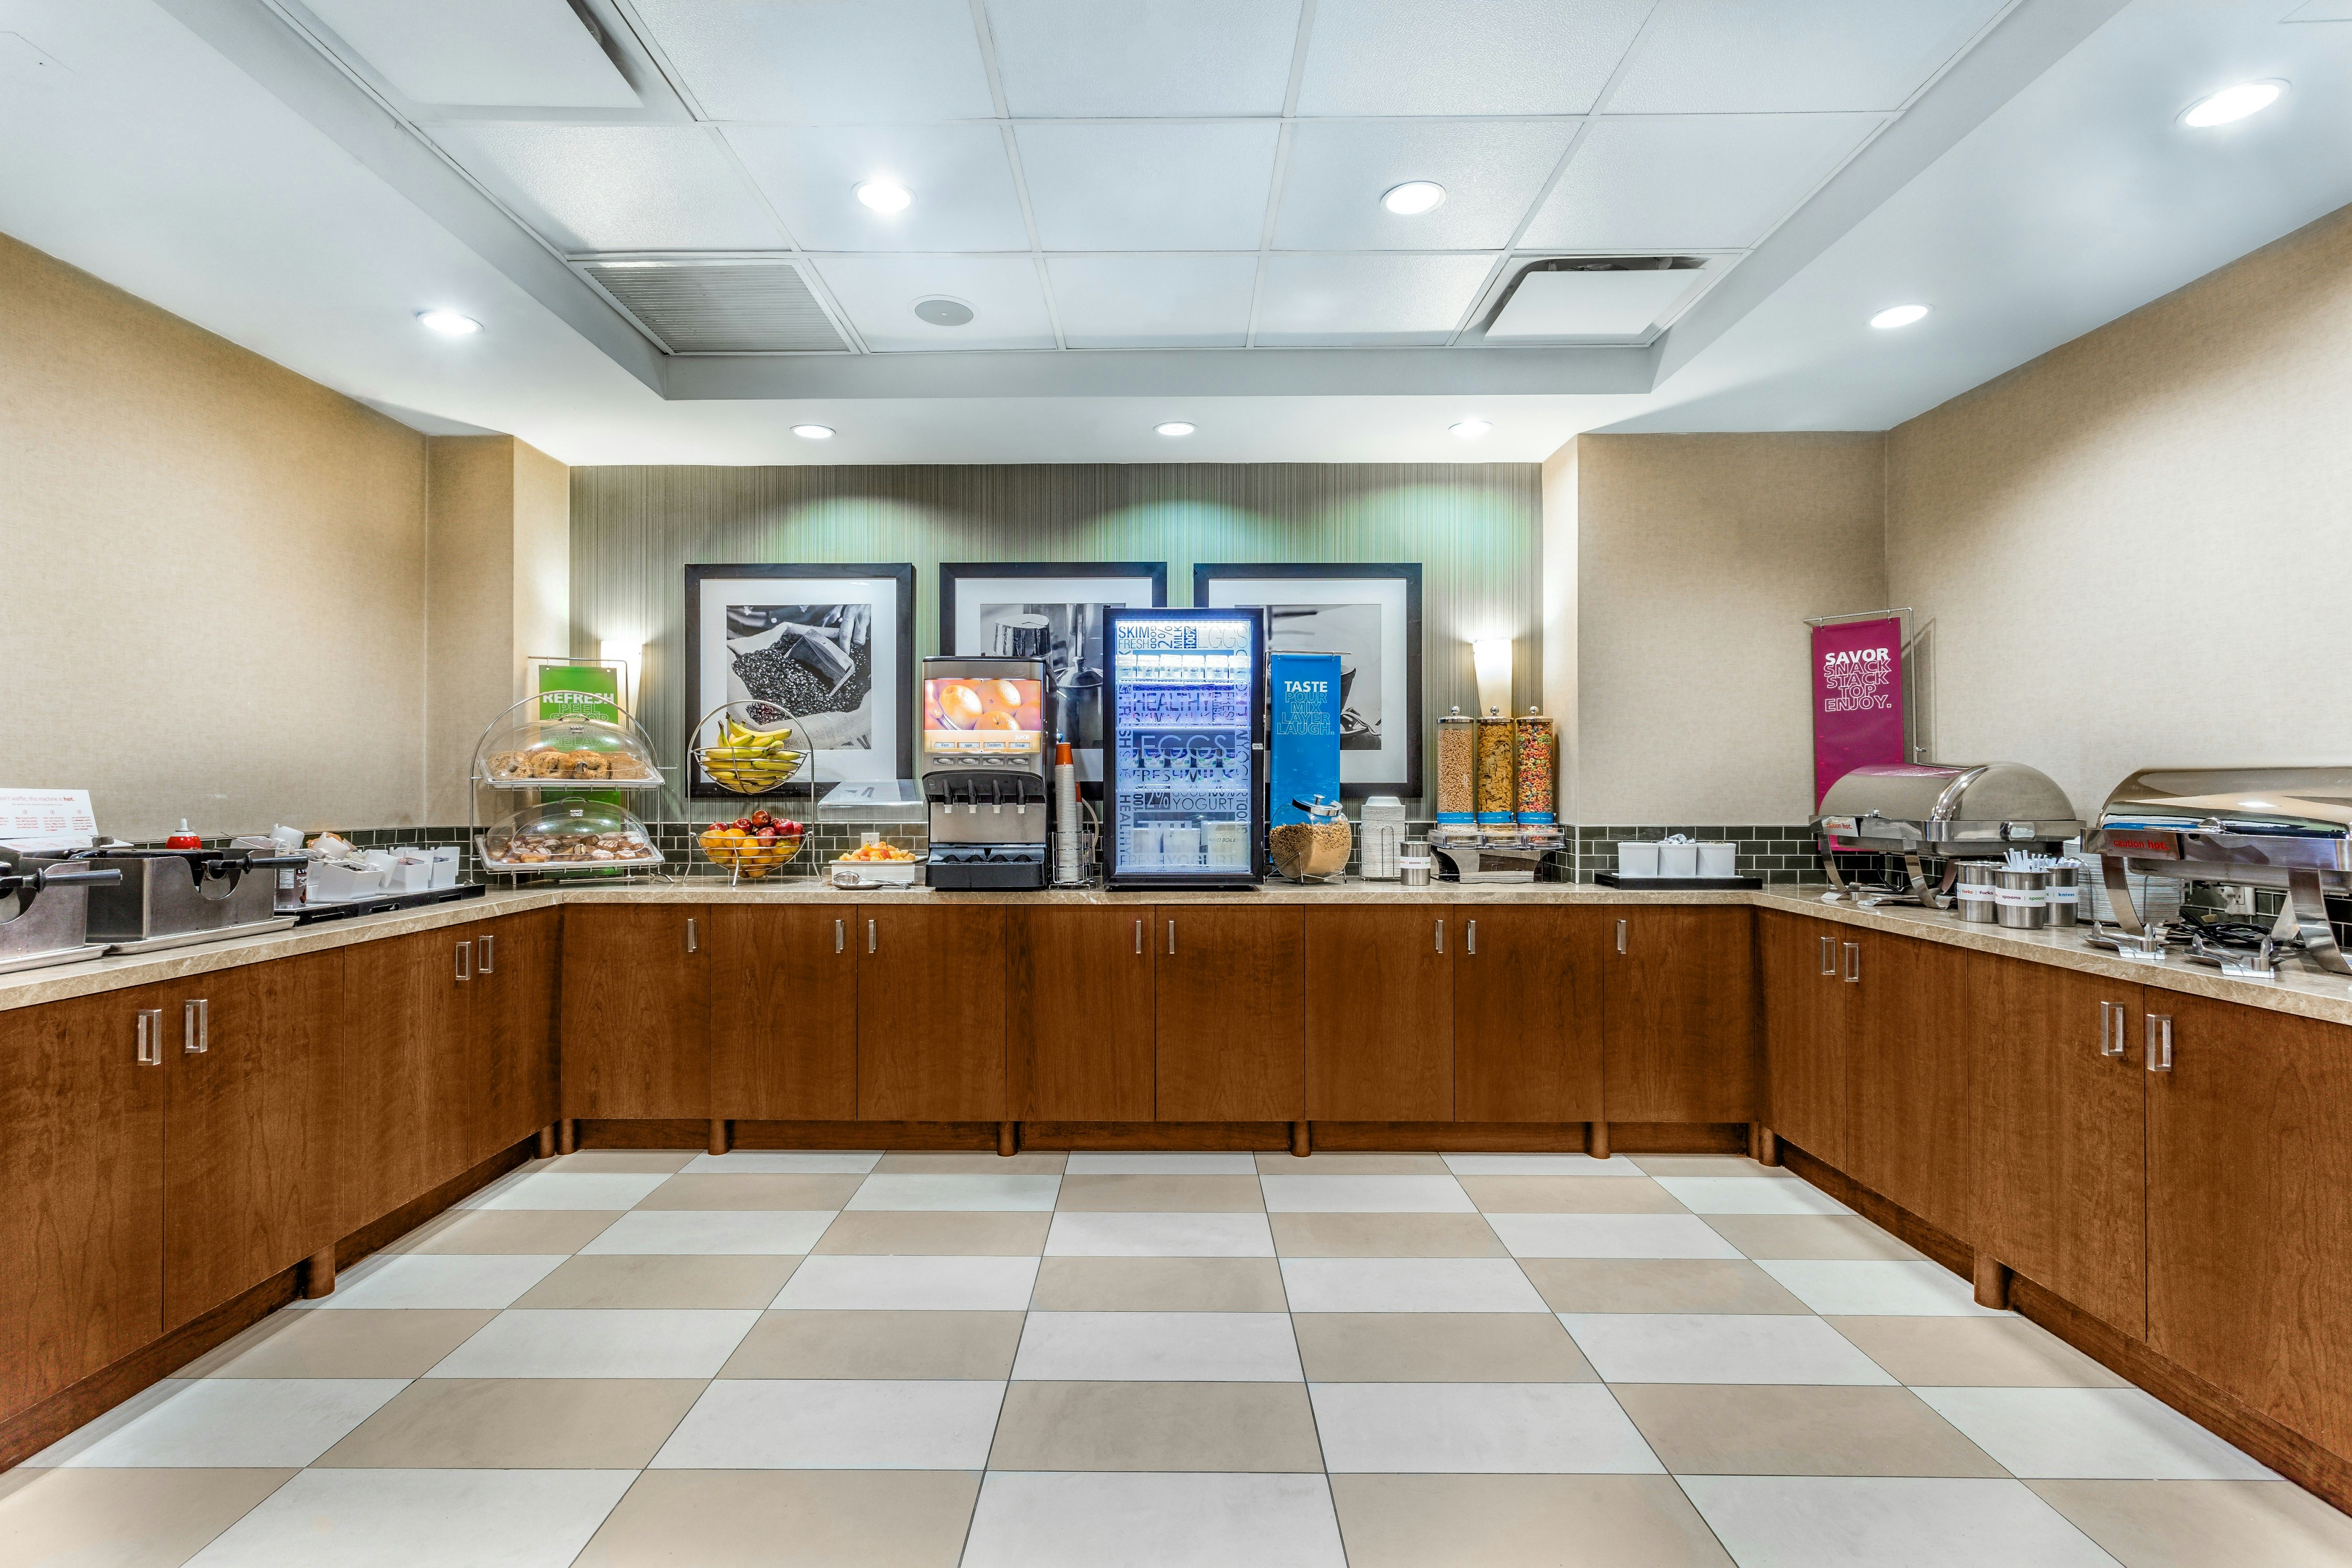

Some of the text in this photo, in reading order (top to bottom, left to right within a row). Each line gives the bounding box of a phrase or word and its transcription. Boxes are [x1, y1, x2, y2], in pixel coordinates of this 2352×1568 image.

[1119, 626, 1149, 638] SKIM
[1158, 626, 1173, 648] 2%
[1174, 626, 1182, 648] MILK
[1184, 626, 1197, 648] 100%
[1198, 626, 1248, 649] EGGS
[1119, 639, 1149, 649] FRESH
[1825, 648, 1889, 665] SAVOR
[1823, 659, 1892, 677] SNACK
[1827, 671, 1889, 688] STACK
[1284, 681, 1328, 693] TASTE
[1839, 684, 1876, 699] TOP
[543, 693, 614, 704] REFRESH
[1133, 693, 1212, 711] HEALTHY
[1285, 691, 1328, 703] POUR
[1825, 695, 1892, 712] ENJOY.
[559, 702, 601, 714] PEEL
[1291, 701, 1321, 713] MIX
[1282, 712, 1330, 724] LAYER
[556, 727, 602, 736] SLCE
[1277, 723, 1335, 735] LAUGH.
[549, 735, 610, 747] RELAX.
[1141, 734, 1227, 759] EGGS
[1133, 769, 1182, 782] FRESH
[1172, 798, 1234, 811] YOGURT
[1120, 793, 1132, 855] HEALTHY
[2113, 839, 2169, 850] caution hot.
